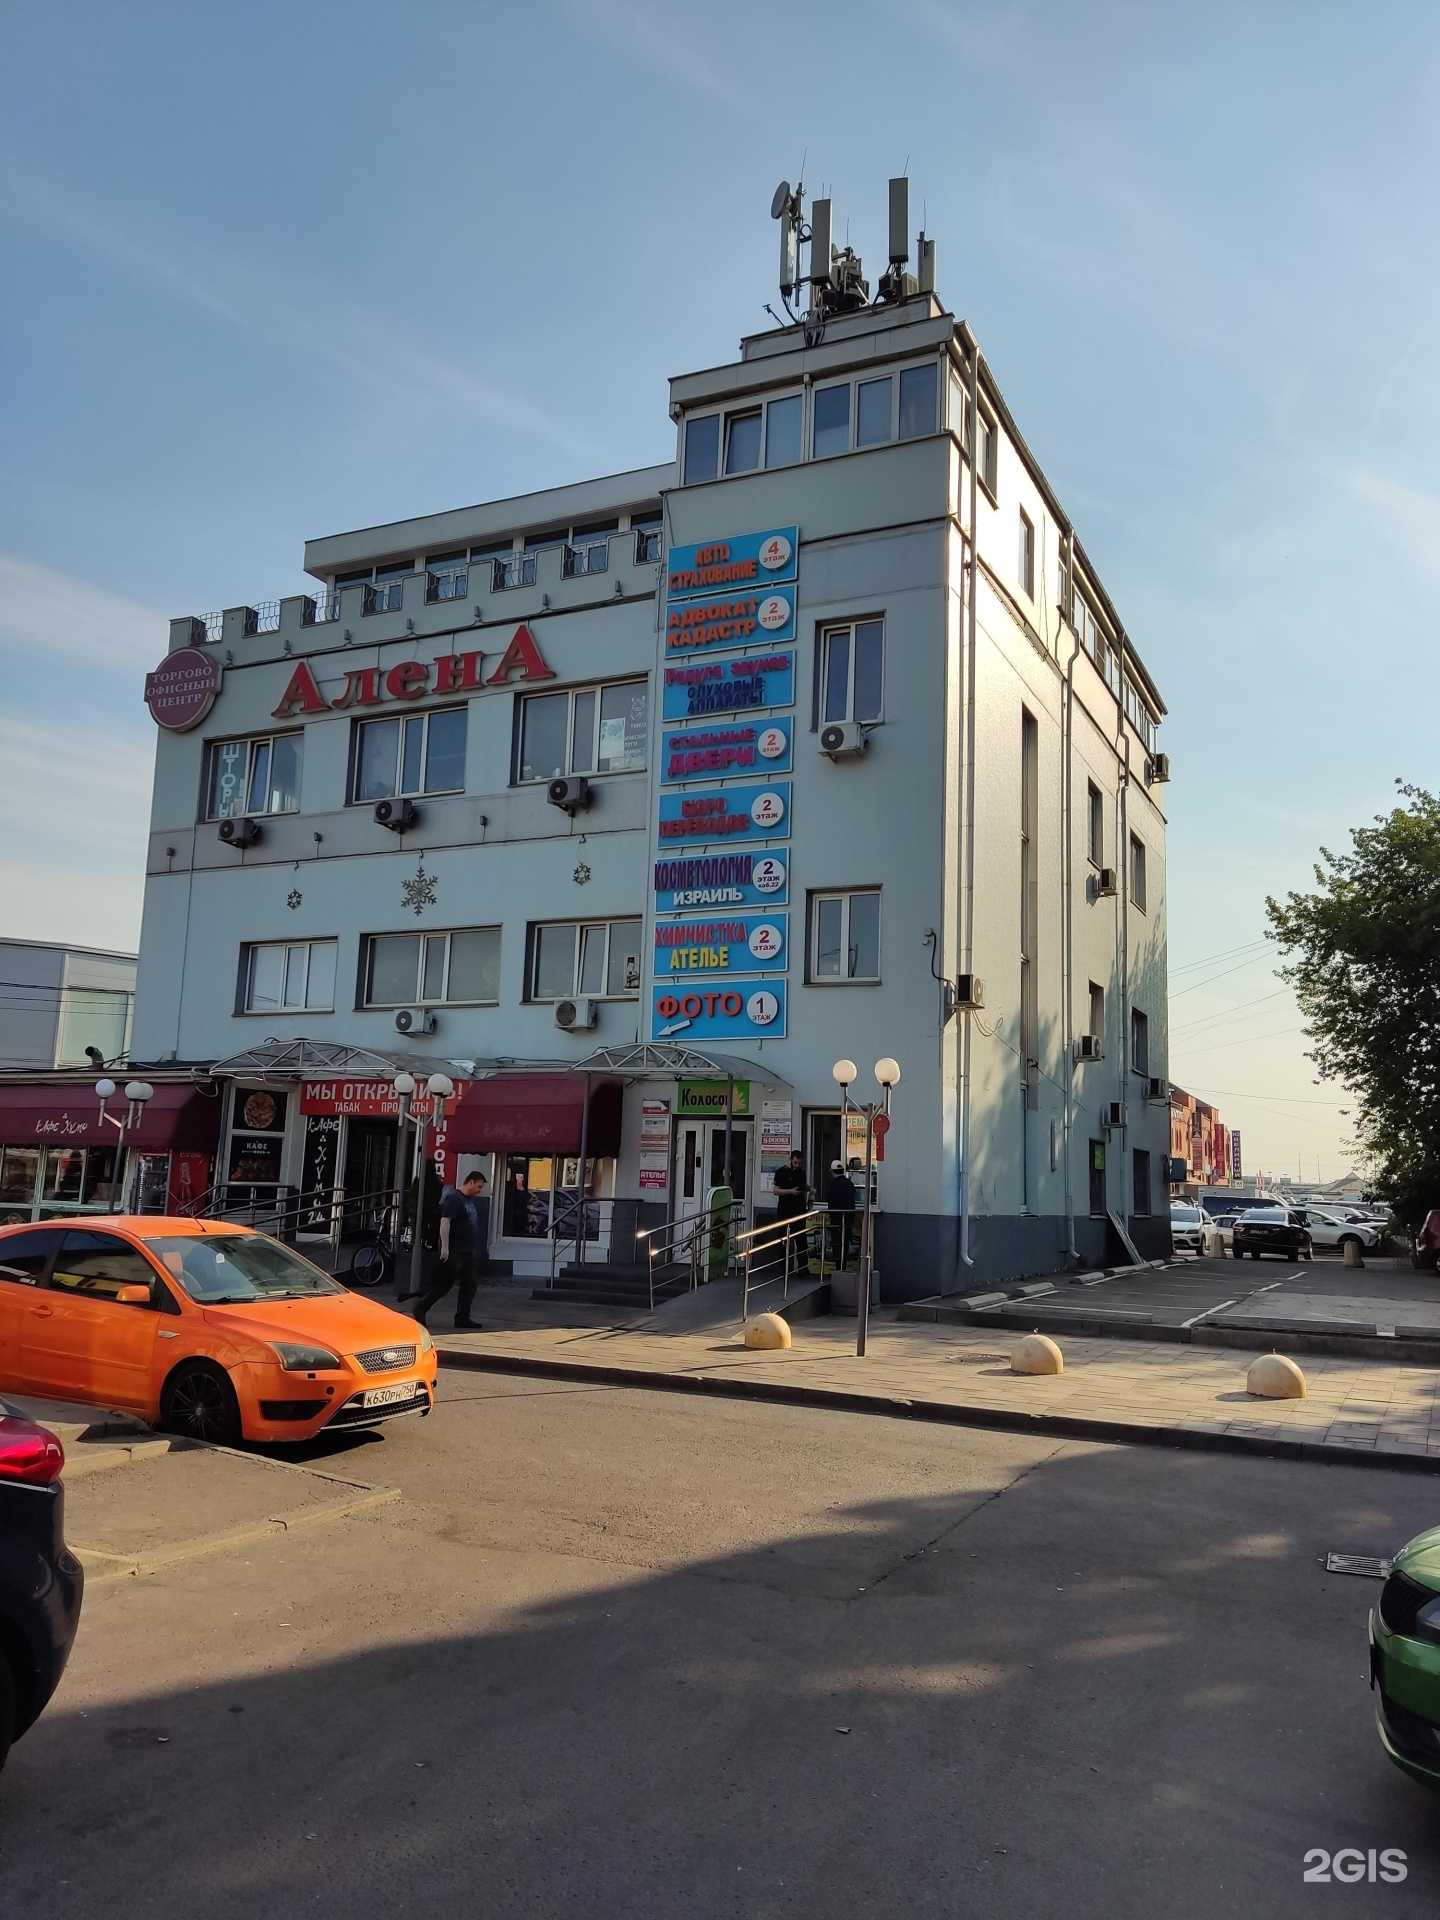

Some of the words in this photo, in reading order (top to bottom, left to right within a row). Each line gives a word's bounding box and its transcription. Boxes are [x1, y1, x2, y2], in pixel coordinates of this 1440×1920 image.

[695, 543, 730, 567] АВТО
[767, 541, 779, 555] 4
[669, 560, 759, 591] СТРАХОВАНИЕ
[669, 599, 758, 628] АДВОКАТ
[768, 602, 779, 615] 2
[668, 618, 757, 649] КАДАСТР
[152, 666, 213, 684] ТОРГОВО
[146, 678, 216, 697] ОФИСНЫЙ
[157, 693, 203, 708] ЦЕНТР
[669, 728, 757, 751] СТАЛЬНЫЕ
[767, 733, 777, 746] 2
[667, 746, 755, 777] ДВЕРИ
[762, 799, 772, 811] 2
[654, 855, 754, 891] КОСМЕТОЛОГИЯ
[763, 861, 774, 875] 2
[756, 875, 780, 883] этаж
[673, 887, 743, 906] ИЗРАИЛЬ
[655, 921, 748, 947] ХИМЧИСТКА
[759, 930, 770, 943] 2
[670, 946, 729, 969] АТЕЛЬЕ
[656, 991, 743, 1018] ФОТО
[756, 997, 764, 1014] 1
[306, 1083, 336, 1100] МЫ
[682, 1087, 729, 1108] Колосо
[334, 1101, 360, 1113] ТАБАК
[380, 1101, 429, 1113] ПРОКТЫ
